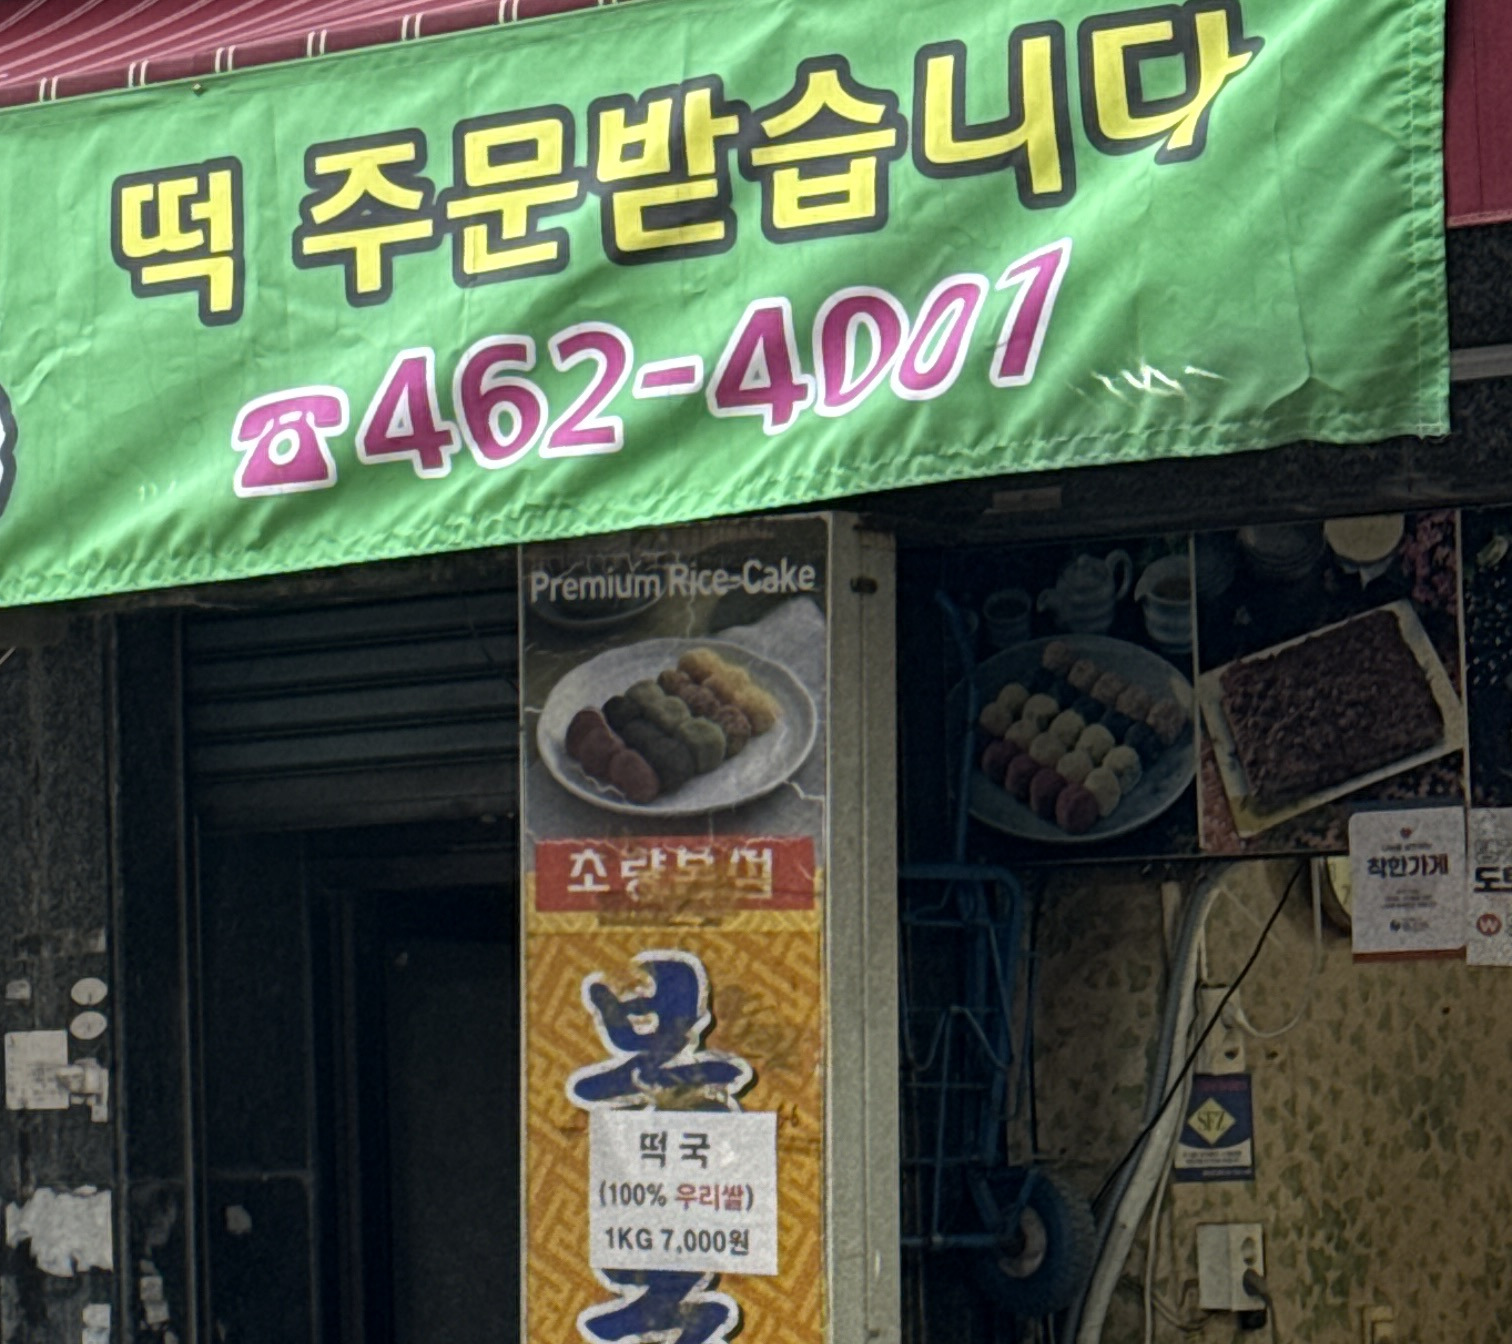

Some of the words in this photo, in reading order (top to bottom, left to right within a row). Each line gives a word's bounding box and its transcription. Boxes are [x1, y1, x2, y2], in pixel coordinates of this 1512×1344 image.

[112, 156, 244, 326] 떡
[357, 237, 1073, 479] 462-4001
[530, 567, 661, 603] Premium
[1367, 853, 1449, 878] 착한가게
[599, 1181, 668, 1208] (100%
[675, 1182, 754, 1212] 우리쌀)
[606, 1228, 653, 1251] 1KG
